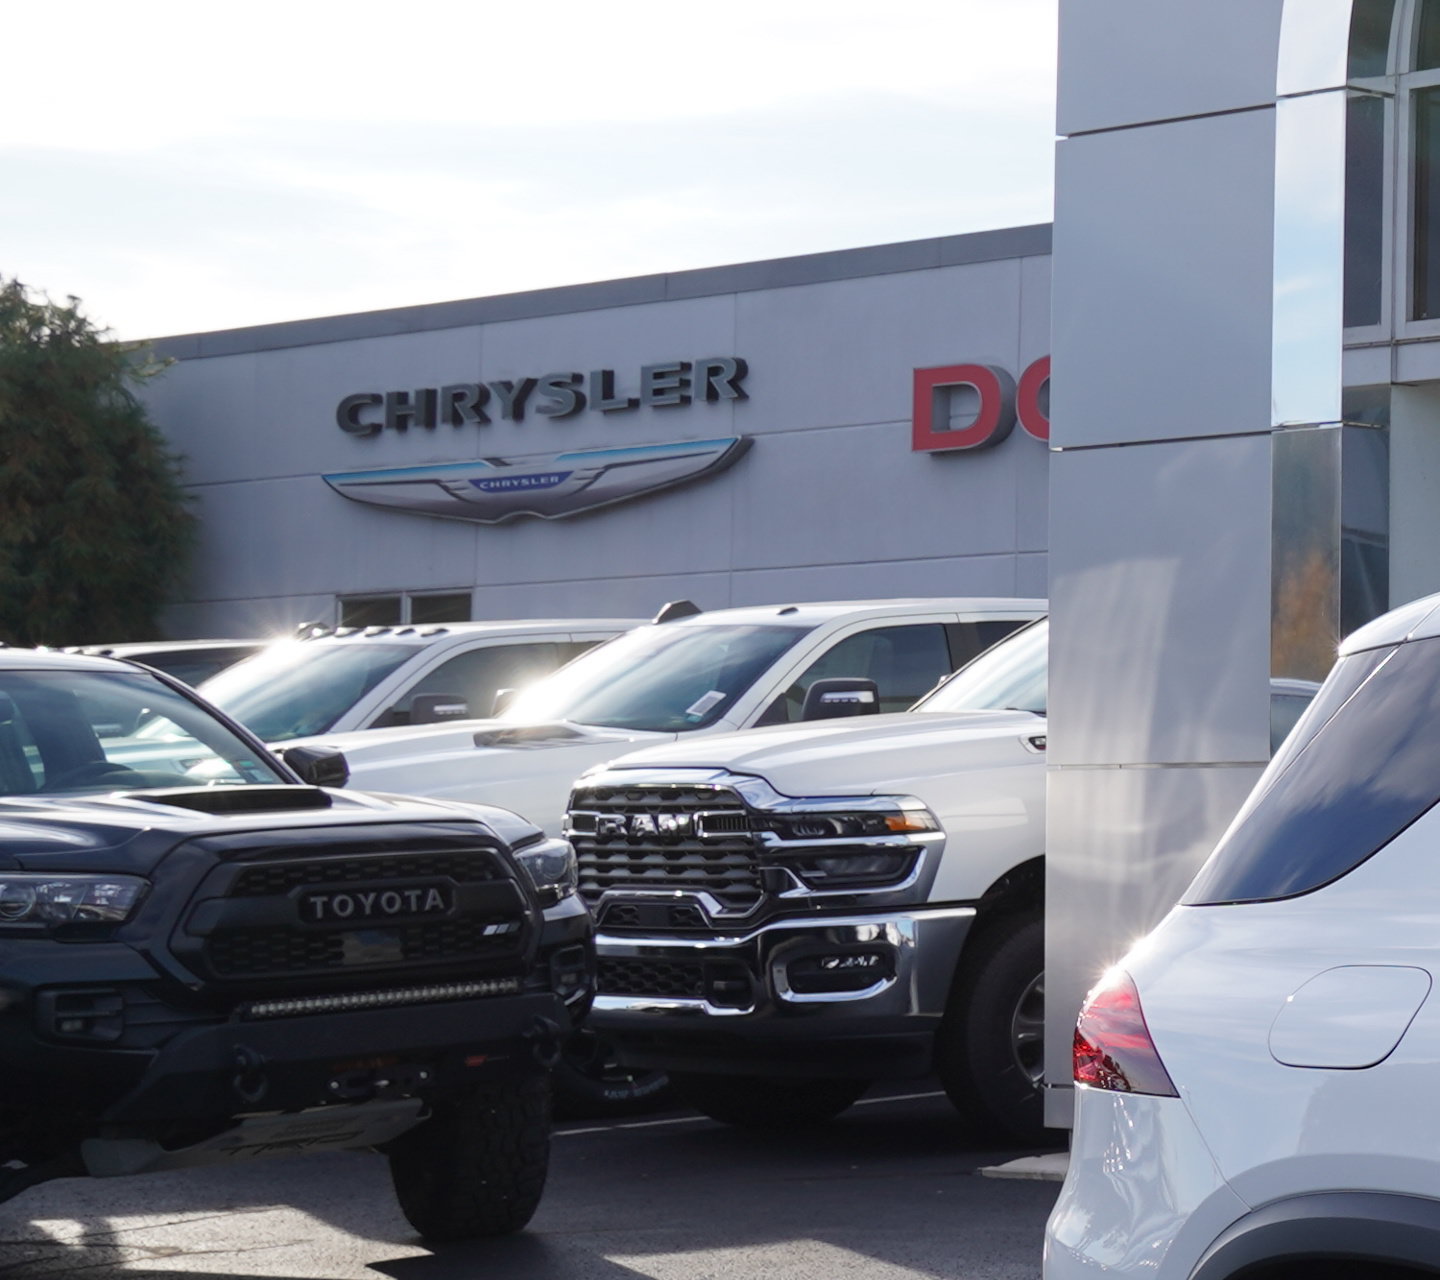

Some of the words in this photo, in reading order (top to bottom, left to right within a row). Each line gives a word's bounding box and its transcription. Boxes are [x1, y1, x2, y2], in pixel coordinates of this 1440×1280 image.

[336, 356, 751, 437] CHRYSLER
[479, 475, 560, 489] CHRYSLER
[599, 813, 693, 837] RAM
[309, 887, 445, 919] TOYOTA
